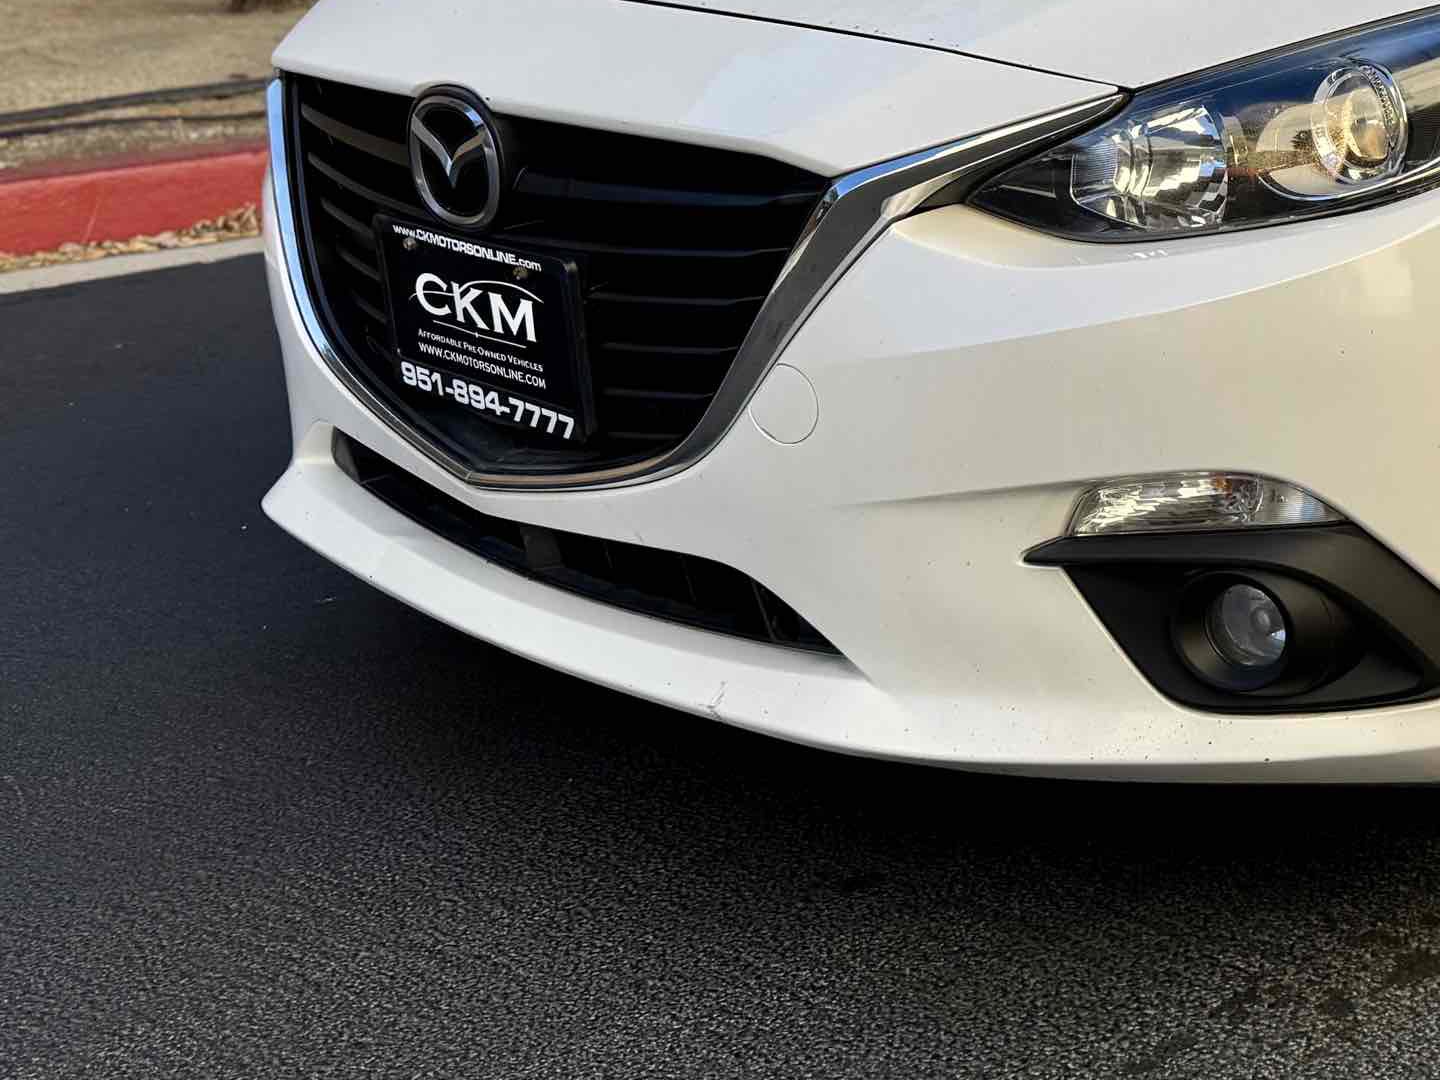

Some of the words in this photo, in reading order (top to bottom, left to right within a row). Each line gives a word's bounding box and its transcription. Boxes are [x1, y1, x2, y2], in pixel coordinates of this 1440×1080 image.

[393, 224, 541, 272] www.CKMOTORSONLINE.com
[415, 272, 537, 343] CKM
[418, 341, 546, 390] WWW.CKMOTORSONLINE.COM
[401, 361, 574, 440] 951-894-7777
